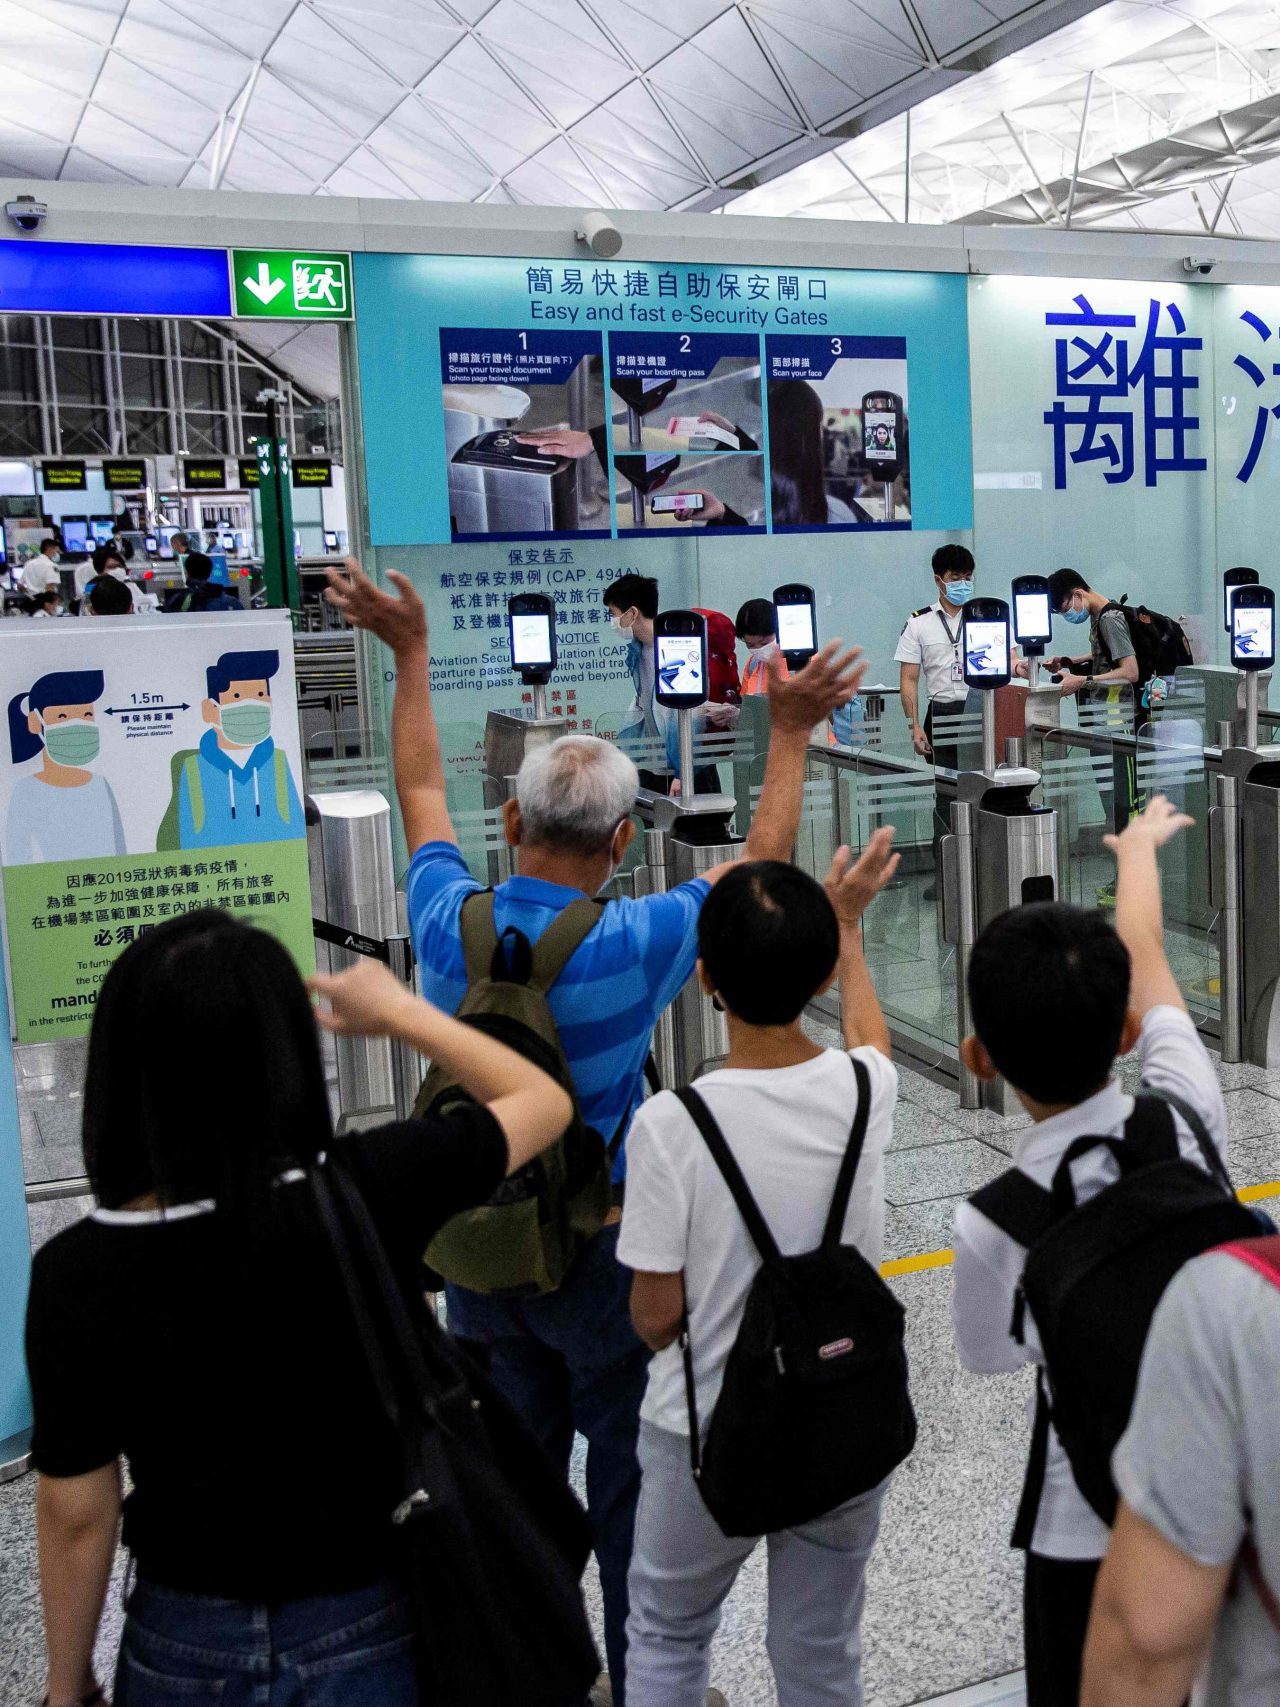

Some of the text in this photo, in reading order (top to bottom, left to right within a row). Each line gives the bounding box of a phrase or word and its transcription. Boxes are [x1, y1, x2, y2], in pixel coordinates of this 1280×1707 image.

[525, 266, 828, 301] 簡易快捷自助保安閘口
[531, 301, 828, 328] Easy and fast e-Security Gates
[518, 332, 527, 350] 1
[680, 335, 691, 353] 2
[831, 338, 842, 355] 3
[448, 365, 552, 375] Scan your travel document
[616, 368, 635, 376] Scan
[636, 369, 654, 377] your
[655, 368, 687, 377] boarding
[772, 369, 823, 378] Scan your face
[508, 549, 575, 564] 保安告示
[440, 569, 542, 589] 航空保安規例
[429, 655, 478, 667] Aviation
[580, 660, 605, 669] valid
[430, 678, 483, 692] boarding
[487, 677, 513, 689] pass
[588, 670, 630, 682] beyond
[131, 692, 164, 704] 1.5m
[77, 961, 88, 969] To
[76, 977, 90, 985] the
[29, 1018, 36, 1026] in
[38, 1016, 54, 1026] the
